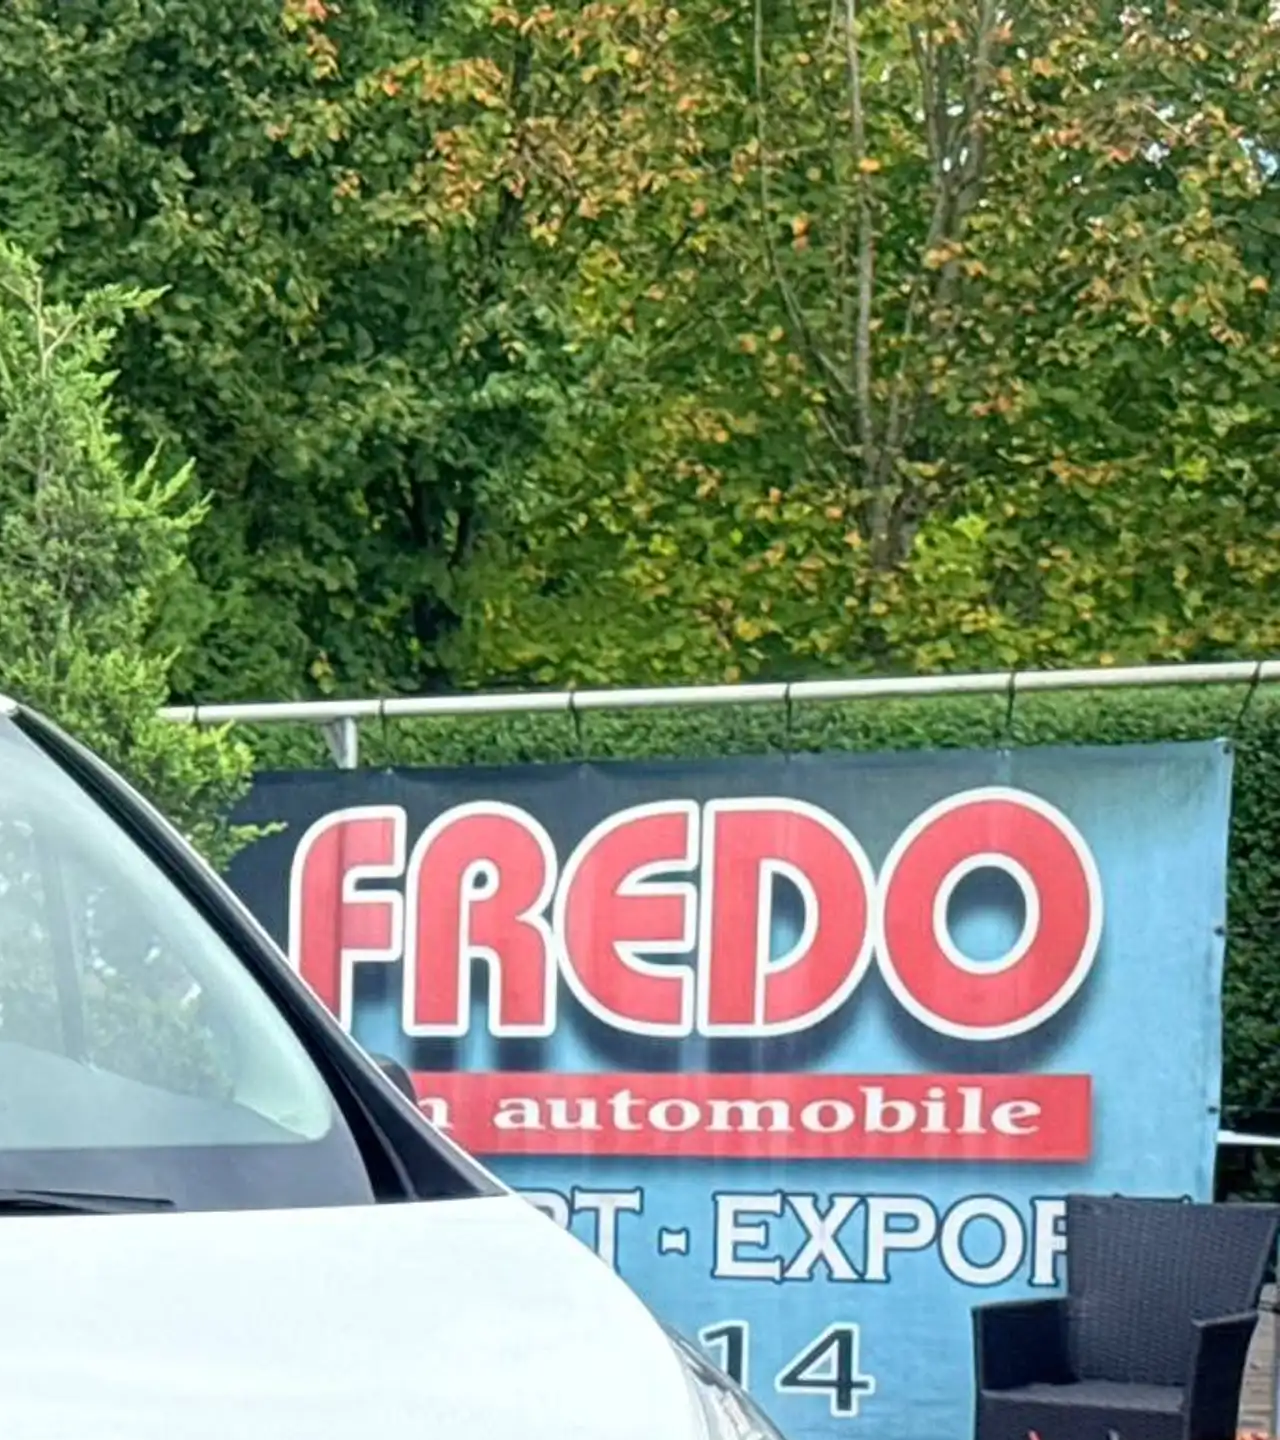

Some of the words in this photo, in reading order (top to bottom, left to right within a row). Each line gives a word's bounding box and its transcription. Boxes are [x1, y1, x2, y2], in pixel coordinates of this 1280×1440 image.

[289, 786, 1103, 1041] FREDO
[493, 1086, 1040, 1136] automobile
[711, 1189, 1068, 1289] EXPO
